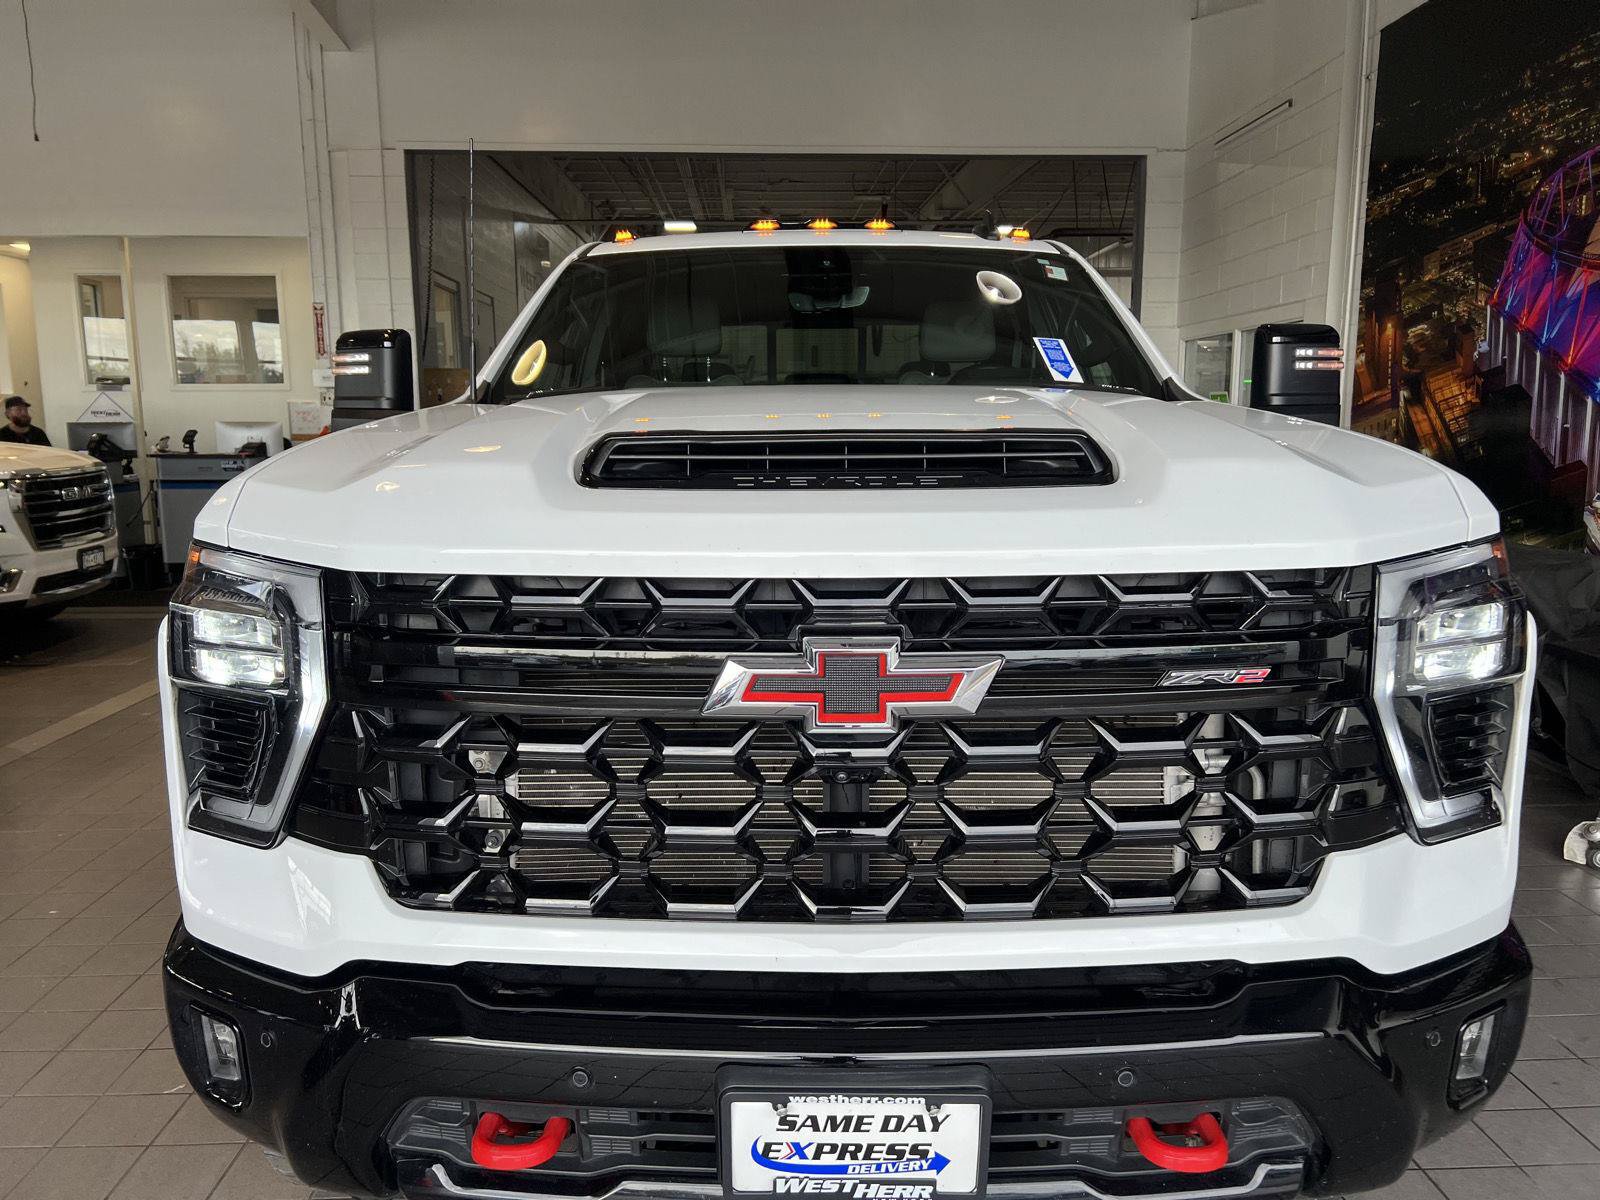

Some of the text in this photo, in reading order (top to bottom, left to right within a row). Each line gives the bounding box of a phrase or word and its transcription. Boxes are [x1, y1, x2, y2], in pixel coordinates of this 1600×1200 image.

[1162, 668, 1271, 685] ZR2
[788, 1094, 926, 1105] westherr.com
[776, 1114, 951, 1132] SAME DAY
[761, 1142, 932, 1161] EXPRESS
[847, 1159, 932, 1175] DELIVERY
